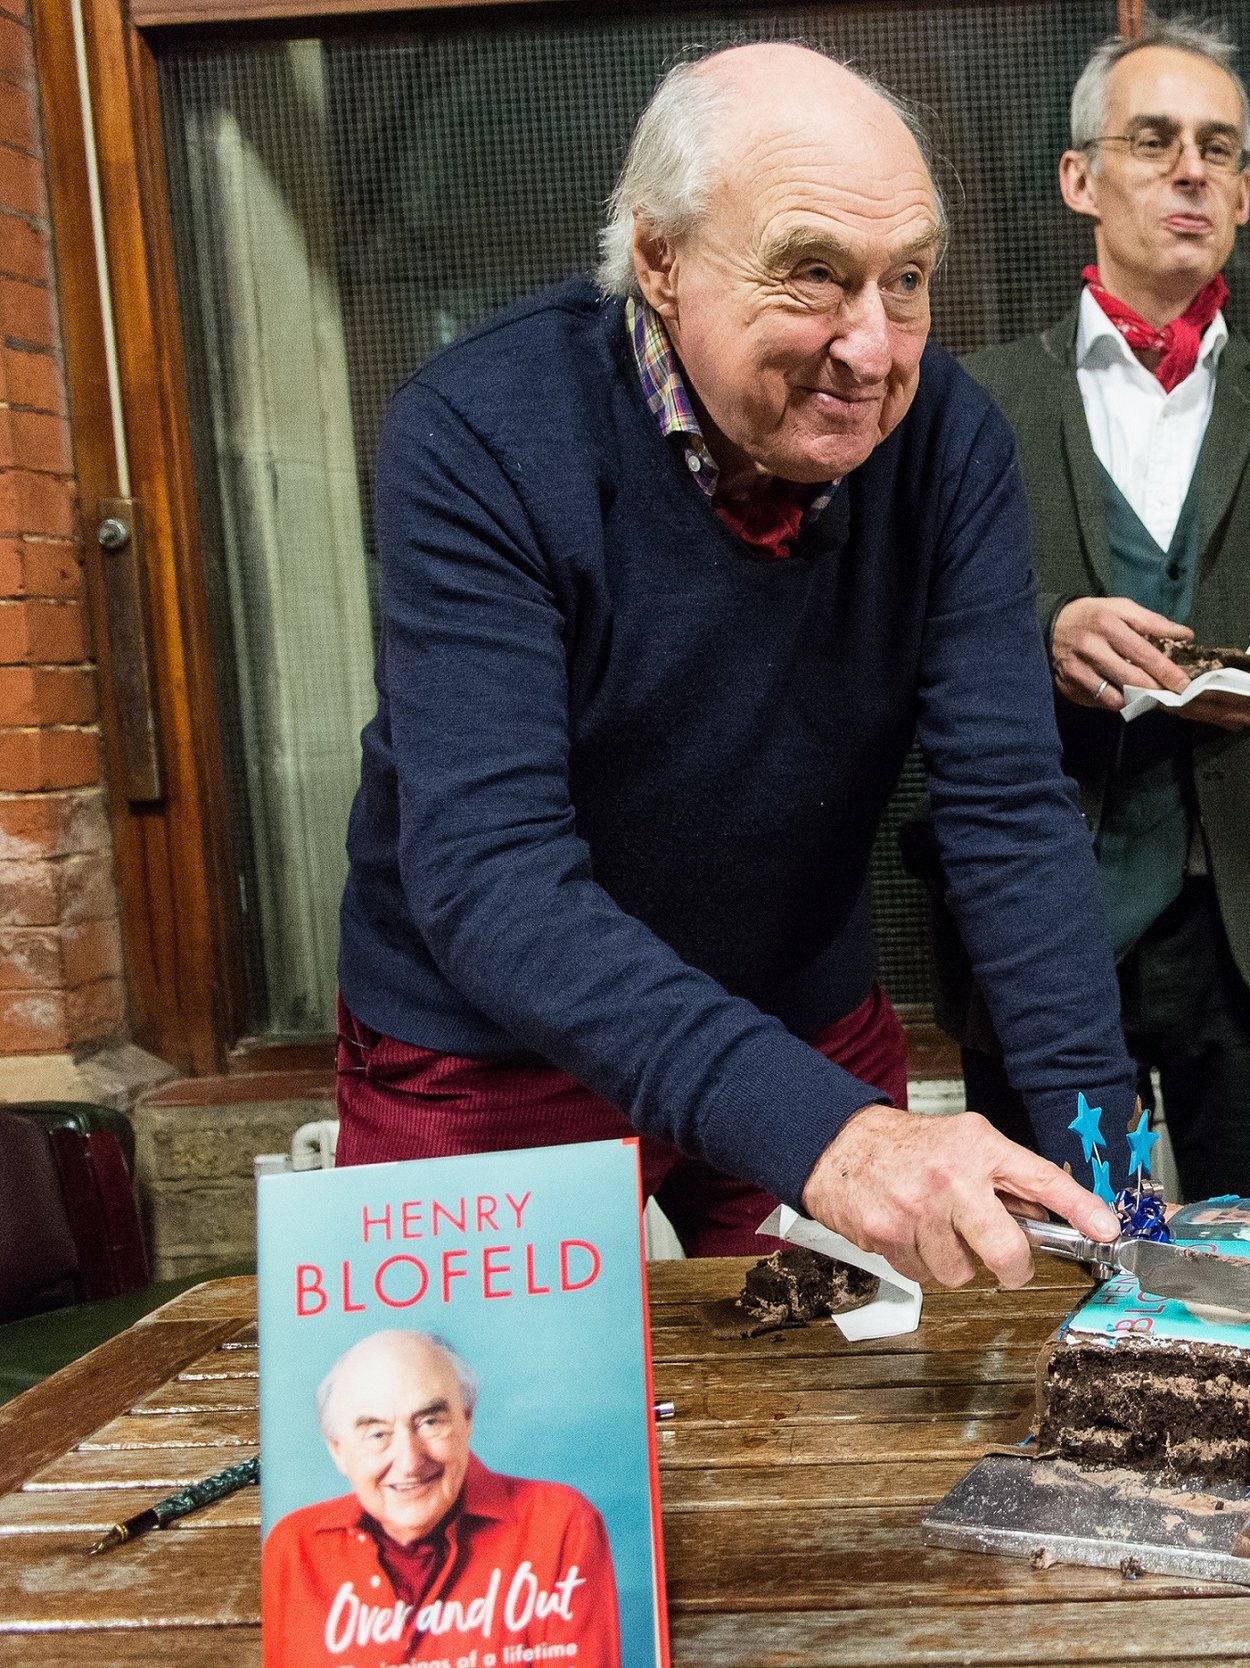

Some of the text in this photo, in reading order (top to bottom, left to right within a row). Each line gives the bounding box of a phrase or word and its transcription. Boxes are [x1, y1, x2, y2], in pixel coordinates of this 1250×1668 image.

[361, 1191, 532, 1243] HENRY
[295, 1238, 602, 1317] BLOFELD
[325, 1560, 586, 1653] Over and Out
[457, 1649, 478, 1668] of
[483, 1653, 497, 1667] a
[503, 1641, 578, 1664] lifetime
